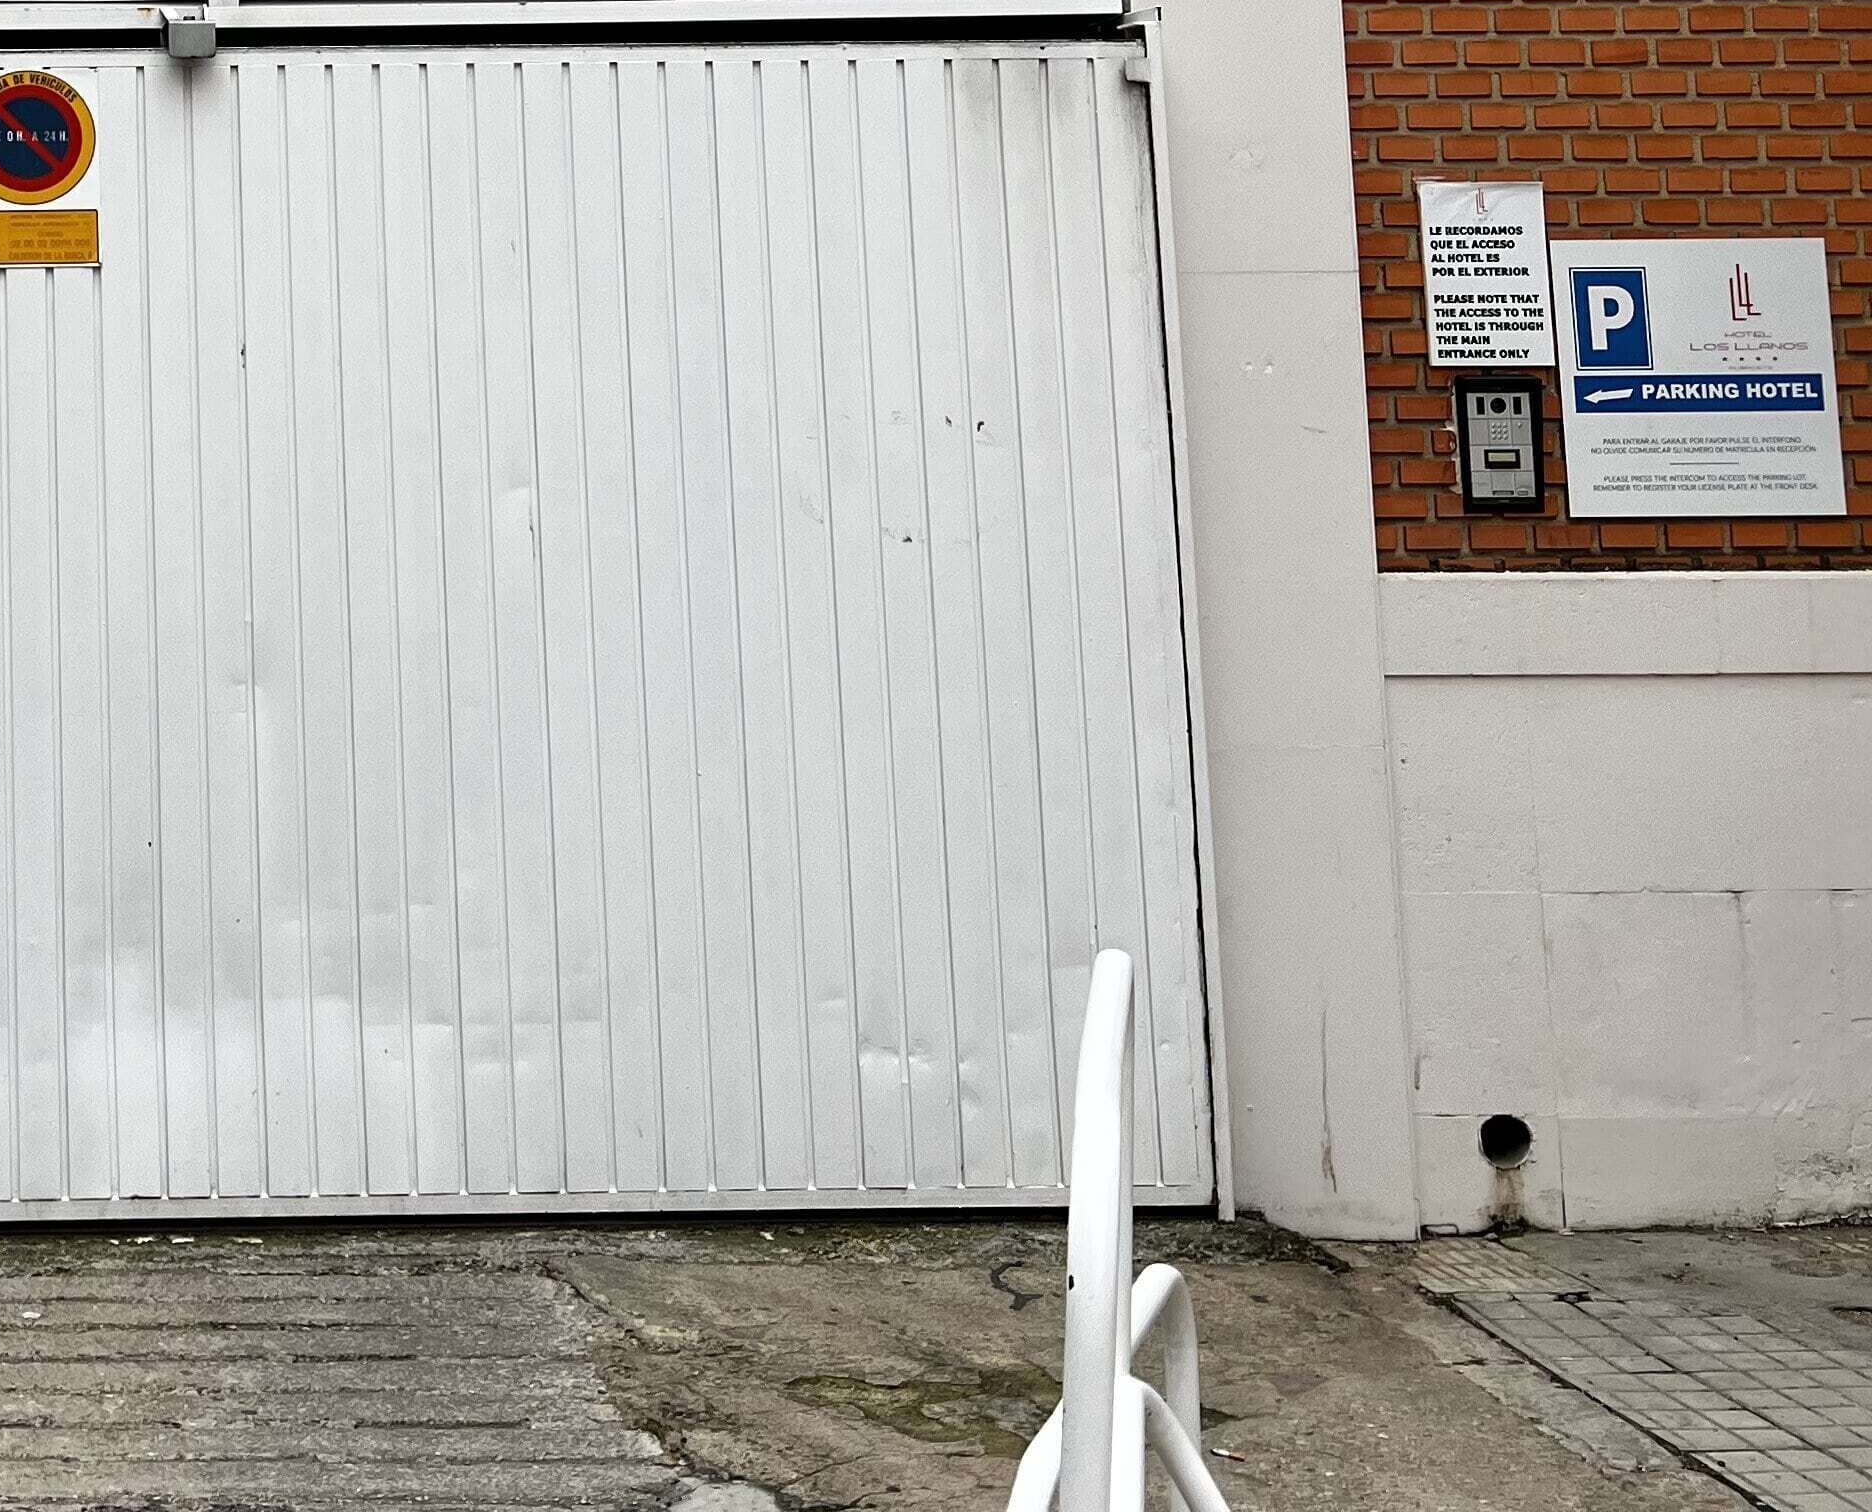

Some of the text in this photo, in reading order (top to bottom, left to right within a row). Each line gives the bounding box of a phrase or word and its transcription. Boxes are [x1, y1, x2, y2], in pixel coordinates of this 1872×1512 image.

[12, 74, 24, 84] DE
[29, 73, 78, 104] VEHICULOS
[32, 130, 40, 142] A
[44, 130, 56, 142] 24
[1430, 226, 1523, 236] LE RECORDAMOS
[1430, 240, 1516, 250] QUE EL ACCESO
[1431, 254, 1500, 263] AL HOTEL ES
[1432, 268, 1530, 276] POR EL EXTERIOR
[1434, 294, 1540, 304] PLEASE NOTE THAT
[1434, 308, 1544, 318] THE ACCESS TO THE
[1588, 286, 1634, 351] P
[1436, 322, 1544, 331] HOTEL IS THROUGH
[1436, 336, 1490, 344] THE MAIN
[1689, 342, 1808, 351] LOS LLANOS
[1438, 350, 1530, 358] ENTRANCE ONLY
[1642, 382, 1818, 400] PARKING HOTEL
